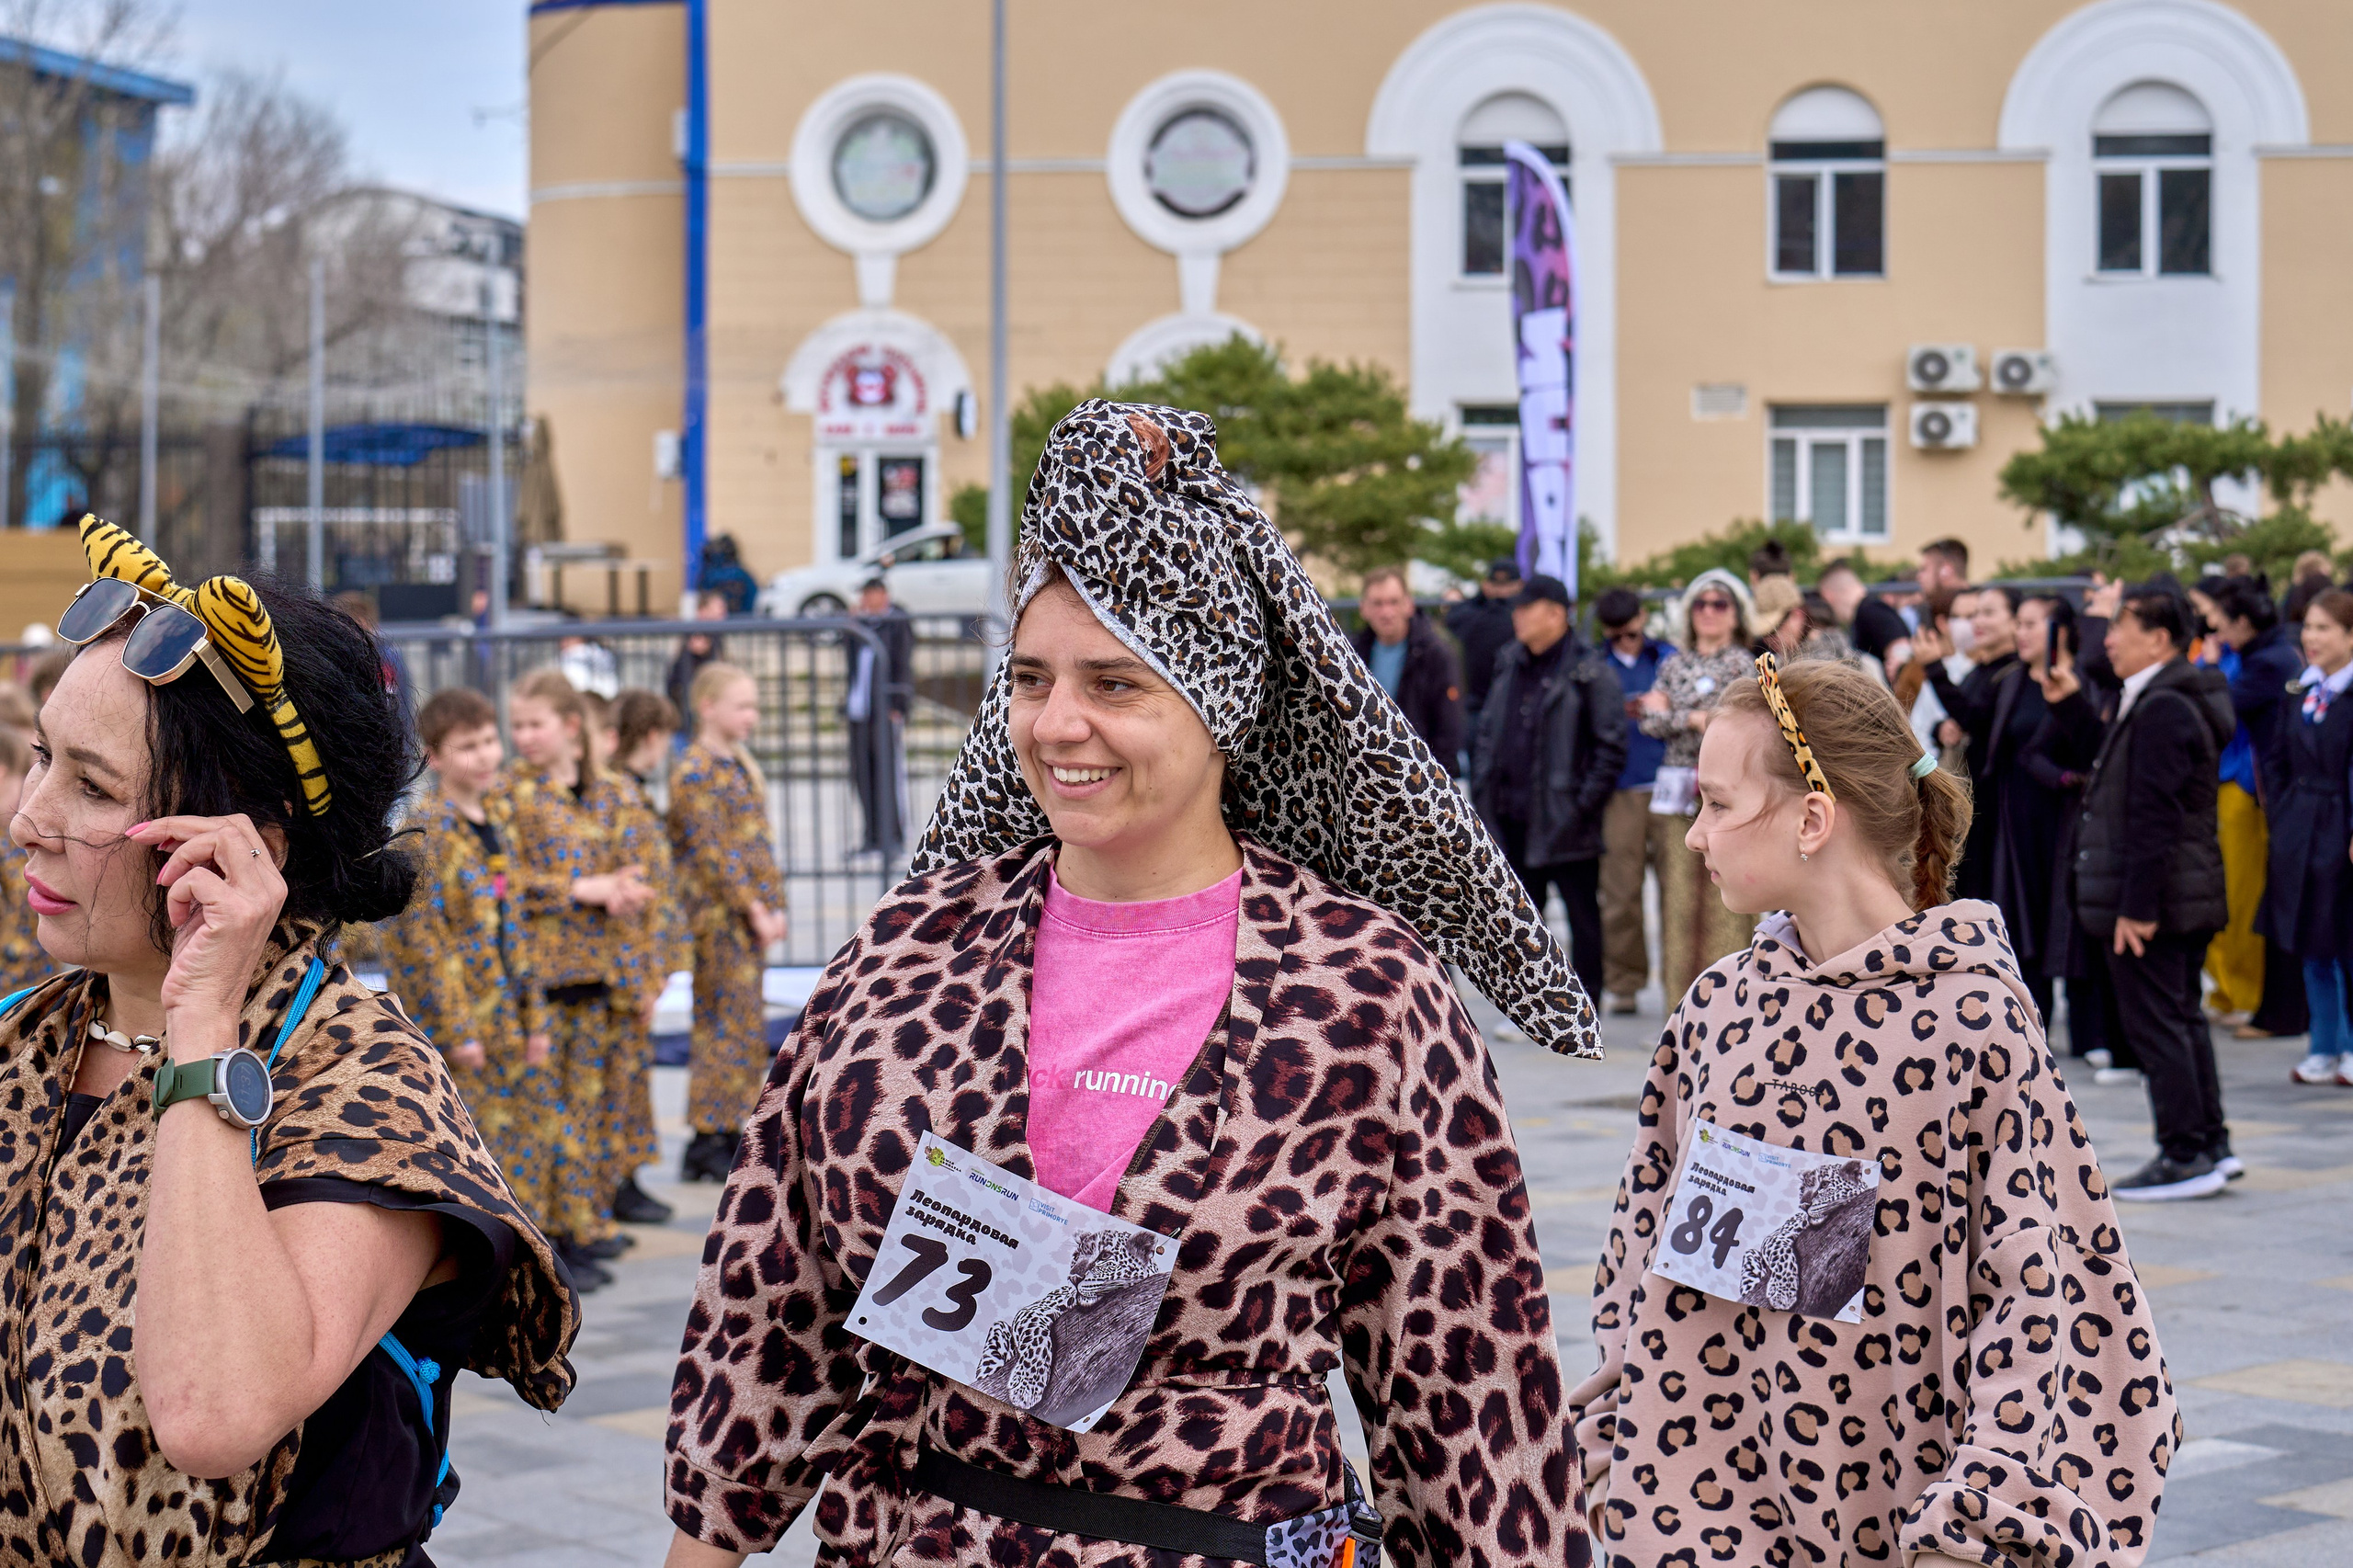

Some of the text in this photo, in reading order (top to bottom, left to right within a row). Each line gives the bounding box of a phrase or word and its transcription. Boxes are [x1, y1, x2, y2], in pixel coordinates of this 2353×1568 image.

[1772, 1078, 1817, 1097] TABOO
[1688, 1175, 1727, 1197] зарядка
[1690, 1162, 1756, 1194] Леопардовая
[909, 1188, 1019, 1250] Леопардовая
[1037, 1208, 1069, 1226] PRIMORYE
[1039, 1202, 1056, 1212] VISIT
[905, 1206, 977, 1245] зарядка
[1670, 1195, 1744, 1269] 84
[871, 1233, 993, 1332] 73
